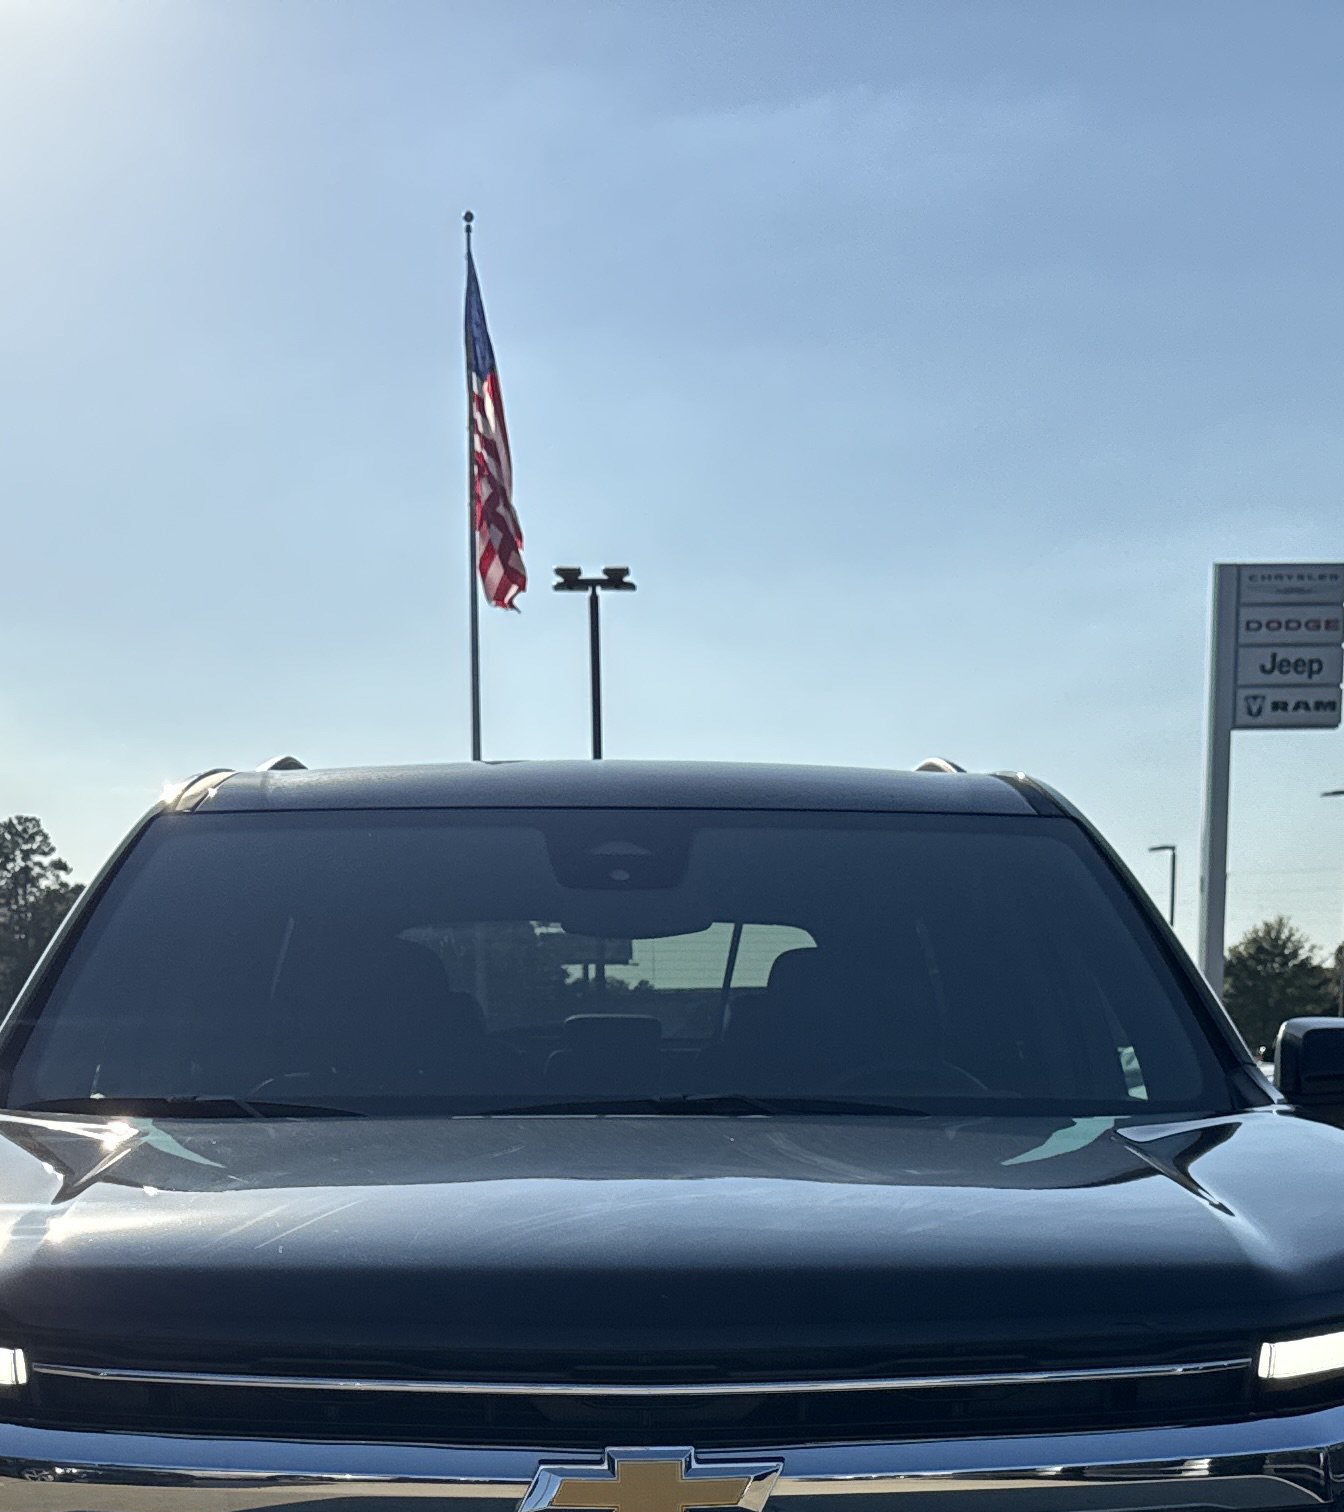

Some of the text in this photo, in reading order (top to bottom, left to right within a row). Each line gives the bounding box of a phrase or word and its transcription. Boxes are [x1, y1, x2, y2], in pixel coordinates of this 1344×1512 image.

[1248, 573, 1340, 583] CHRYSLER
[1245, 619, 1340, 632] DODGE
[1259, 652, 1324, 680] Jeep
[1270, 700, 1338, 713] RAM
